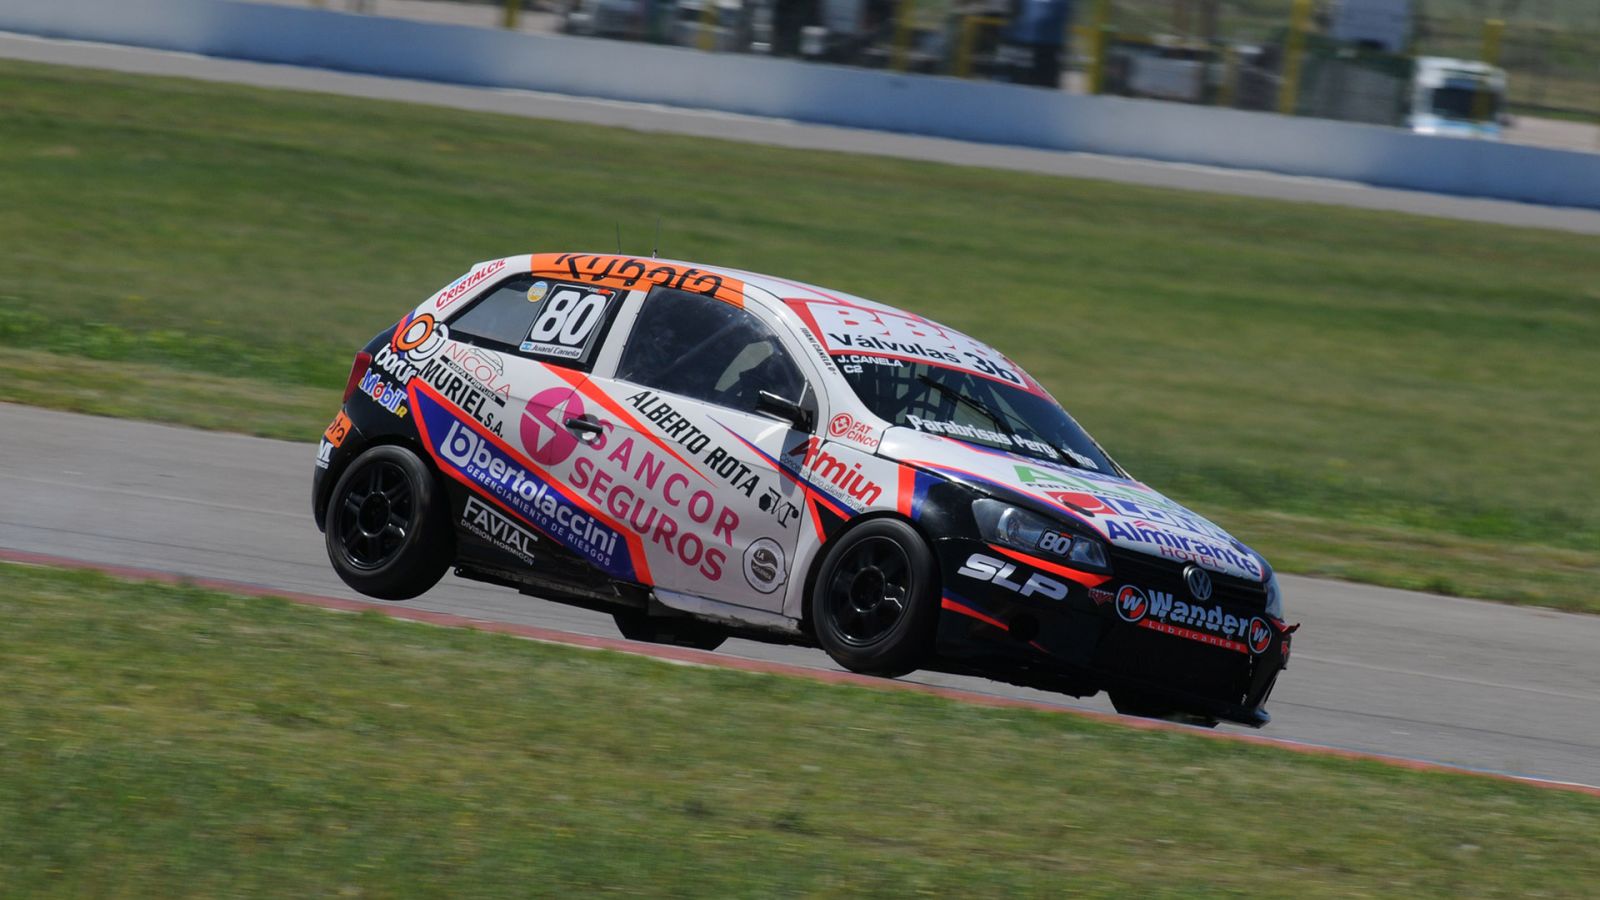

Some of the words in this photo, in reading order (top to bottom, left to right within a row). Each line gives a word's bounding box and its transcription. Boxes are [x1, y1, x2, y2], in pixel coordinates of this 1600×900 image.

[531, 290, 607, 345] 80
[445, 342, 512, 400] NICOLA
[828, 333, 961, 364] Válvulas
[843, 365, 864, 373] C2
[850, 355, 904, 368] CANELA
[419, 358, 486, 422] MURIEL
[625, 390, 711, 455] ALBERTO
[704, 446, 761, 498] ROTA
[846, 430, 879, 448] CINCO
[852, 421, 873, 434] FAT
[905, 414, 1013, 445] Parabrisas
[588, 418, 740, 547] SANCOR
[788, 434, 882, 506] Amiun
[466, 464, 548, 525] GERENCIAMIENTO
[551, 521, 567, 536] DE
[567, 533, 611, 567] RIESGOS
[472, 440, 618, 556] bertolaccini
[567, 456, 727, 582] SEGUROS
[461, 519, 492, 542] DIVISION
[463, 495, 538, 558] FAVIAL
[1039, 532, 1073, 554] 80
[1105, 520, 1260, 577] Almirante
[957, 553, 1069, 600] SLP
[1160, 546, 1226, 570] HOTEL
[1148, 589, 1249, 637] Wander
[1149, 621, 1241, 651] Lubricantes
